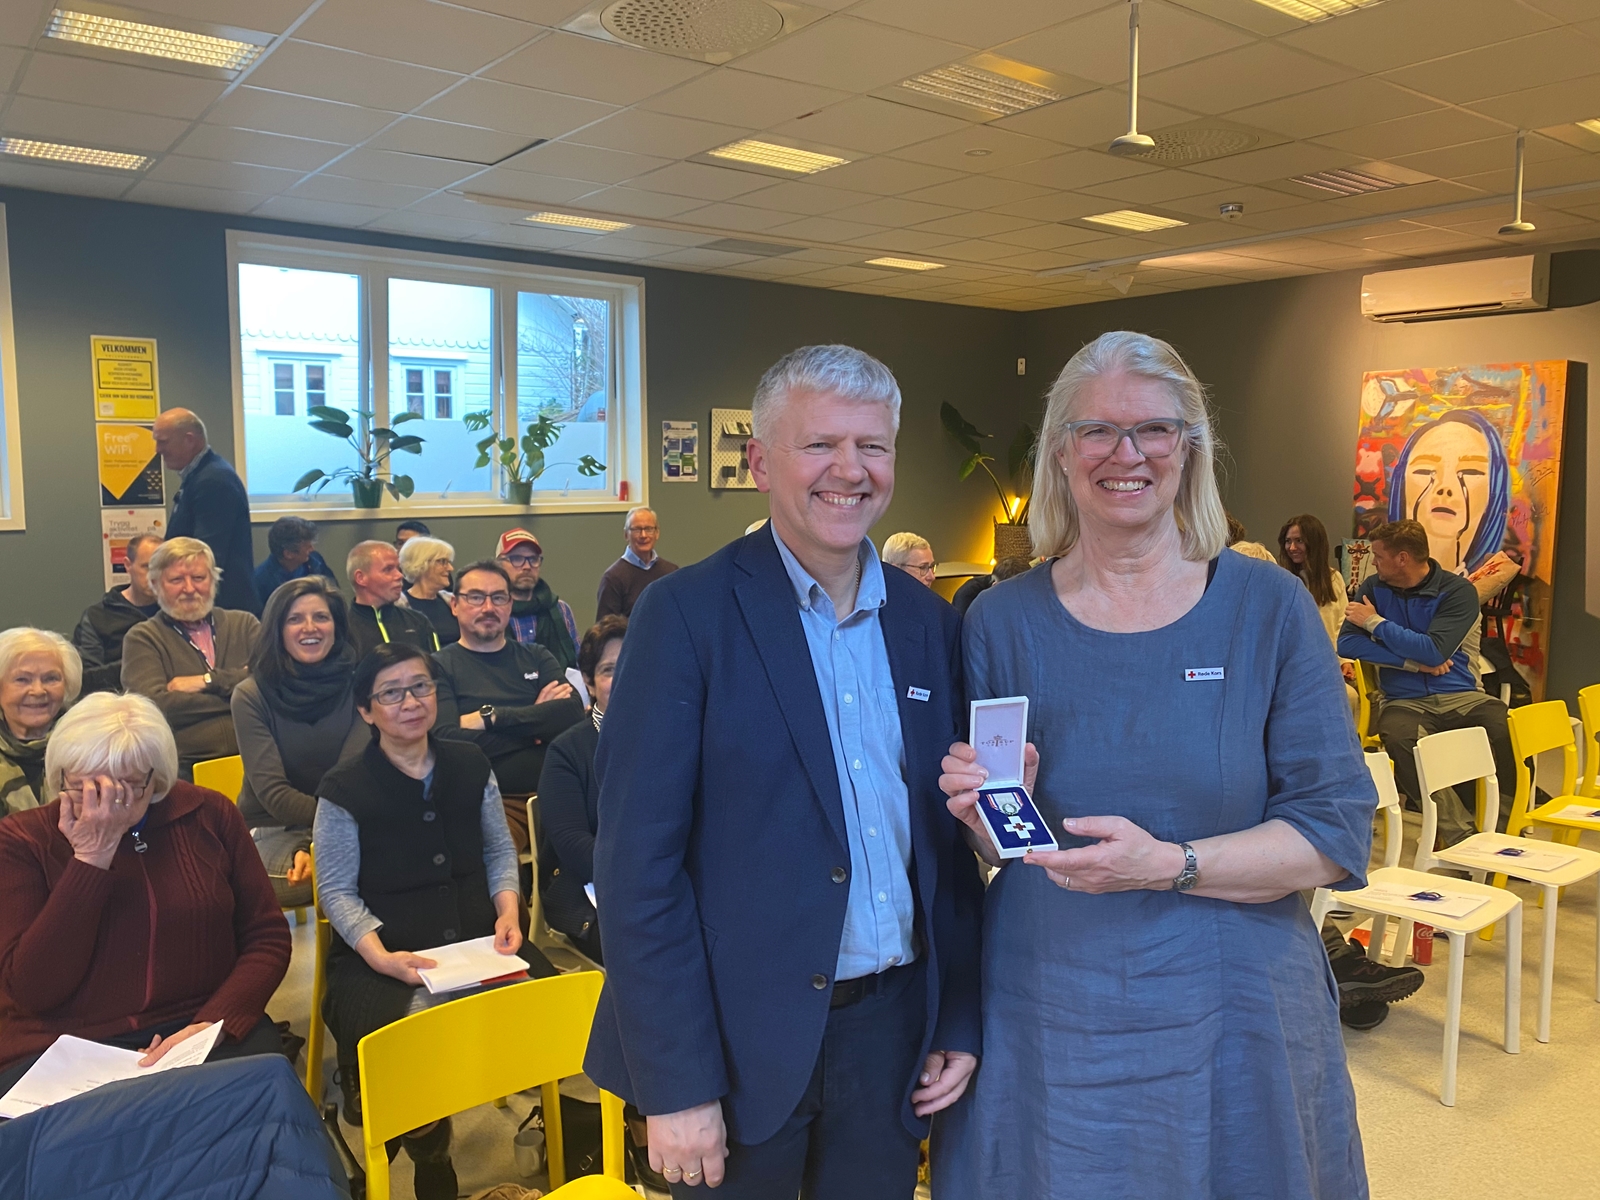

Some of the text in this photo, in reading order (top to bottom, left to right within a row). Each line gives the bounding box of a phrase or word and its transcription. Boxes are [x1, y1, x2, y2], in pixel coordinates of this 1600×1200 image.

[101, 344, 147, 354] VELKOMMEN
[104, 432, 131, 443] Free
[104, 444, 132, 455] WiFi
